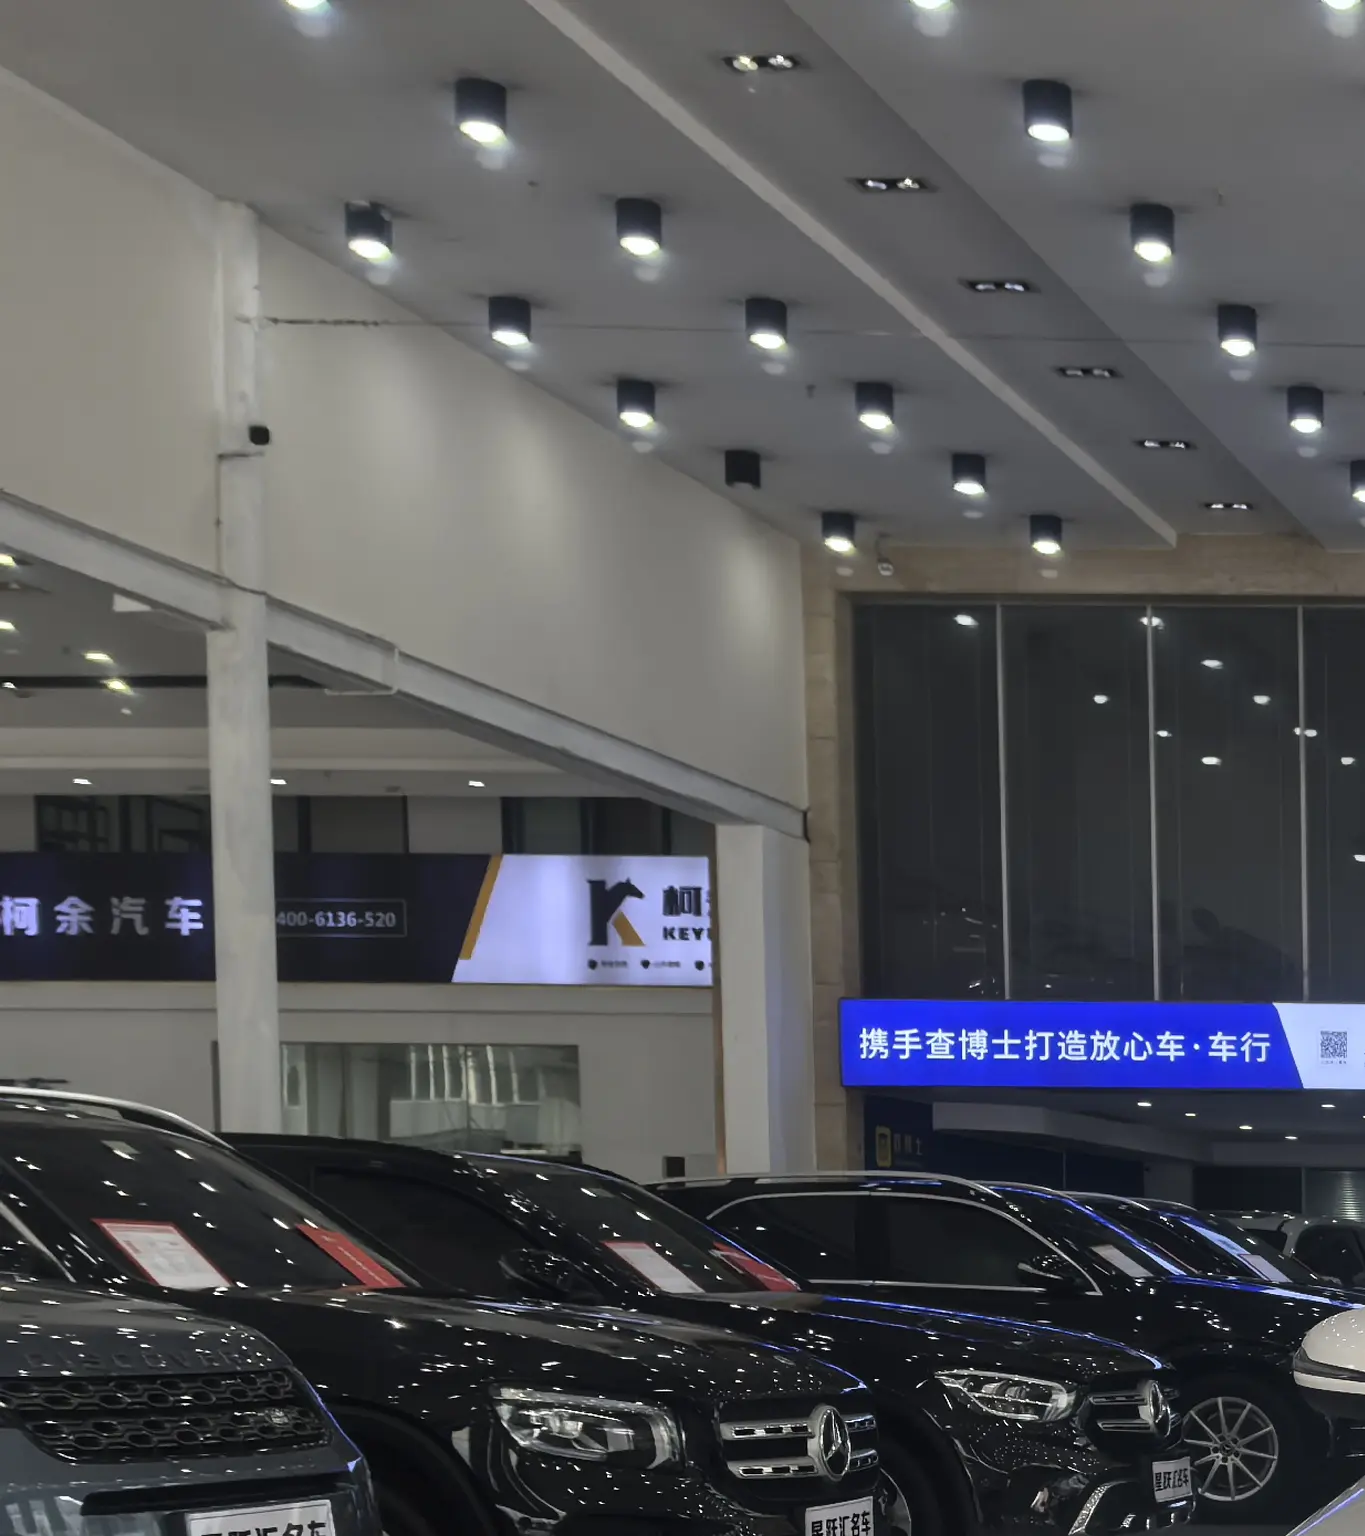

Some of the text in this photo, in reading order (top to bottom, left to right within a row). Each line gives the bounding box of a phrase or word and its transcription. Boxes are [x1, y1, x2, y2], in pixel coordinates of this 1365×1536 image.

[0, 895, 205, 937] 柯余汽车
[662, 885, 711, 917] 柯
[858, 1026, 1271, 1064] 携手查博士打造放心车·车行
